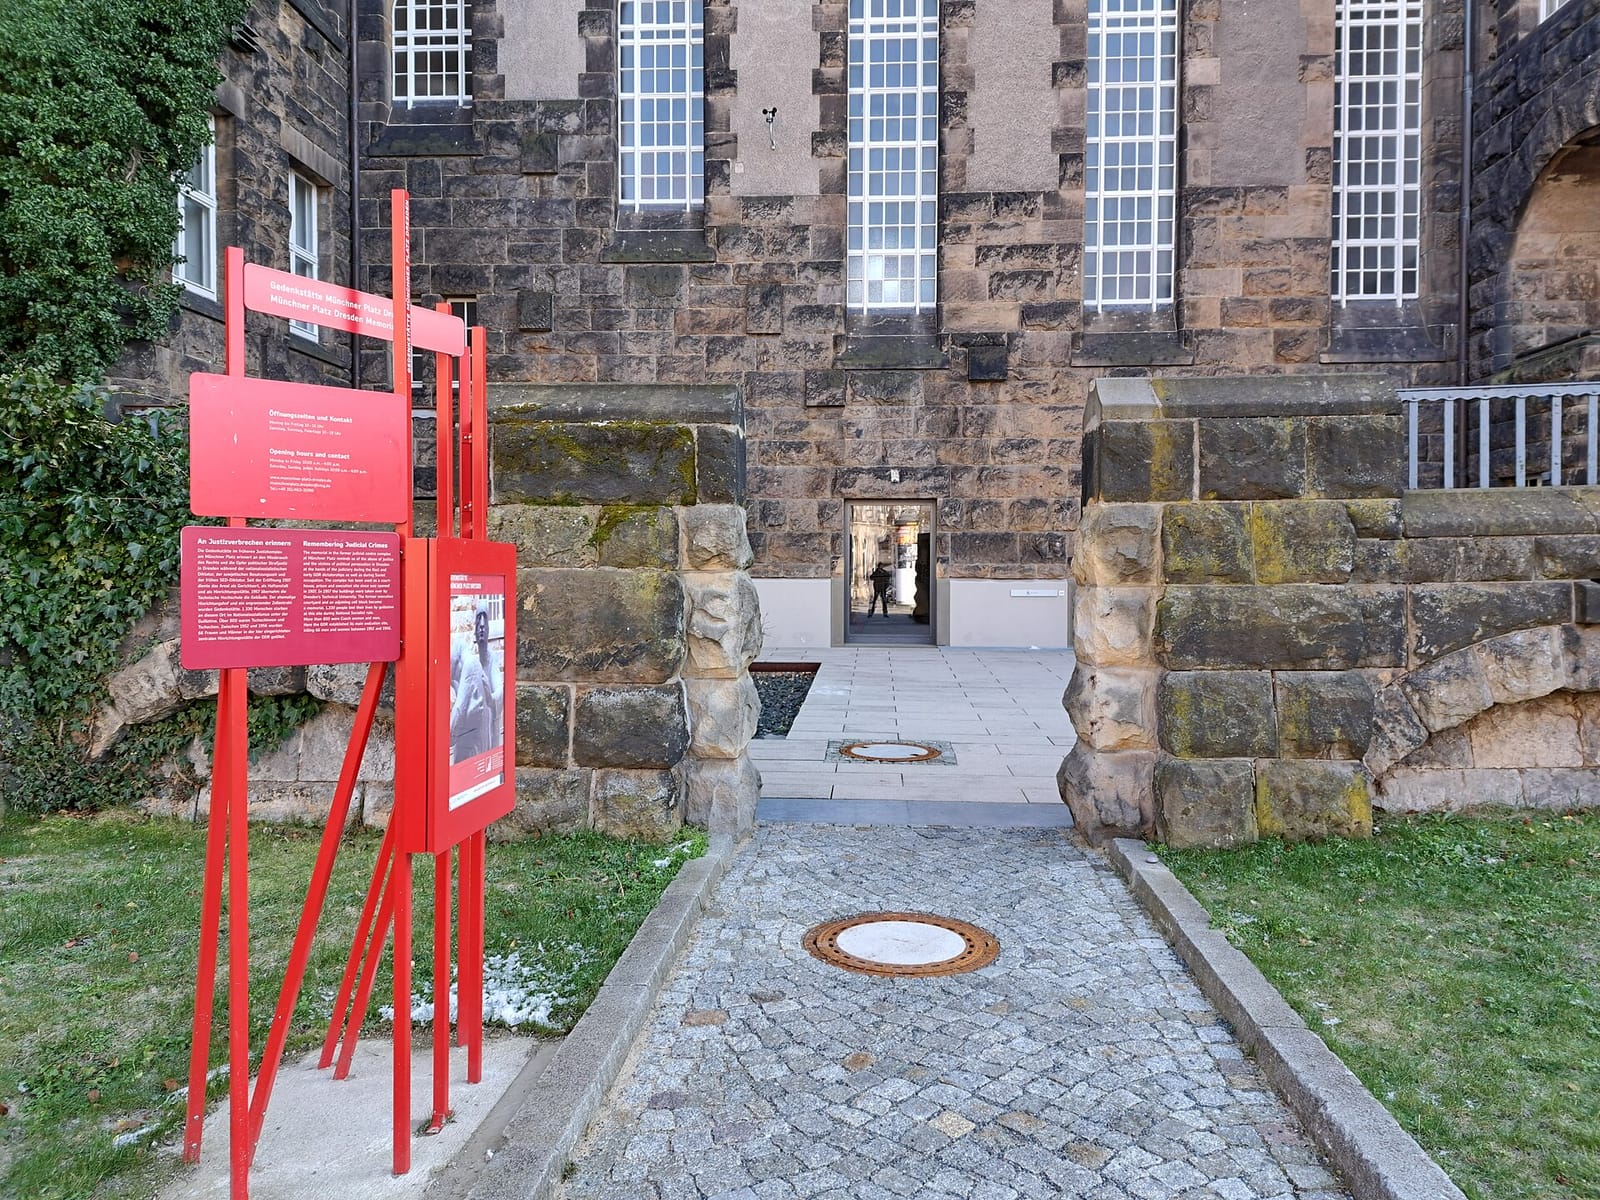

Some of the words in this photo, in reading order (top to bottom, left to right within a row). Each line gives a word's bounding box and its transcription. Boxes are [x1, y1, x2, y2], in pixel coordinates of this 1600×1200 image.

[270, 281, 322, 301] Gedenkstätte
[326, 295, 361, 310] Münchner
[364, 304, 381, 315] Platz
[270, 294, 309, 311] Münchner
[312, 304, 331, 315] Platz
[334, 310, 362, 323] Dresden
[269, 409, 315, 420] Öffnungszeiten
[270, 448, 294, 456] Opening
